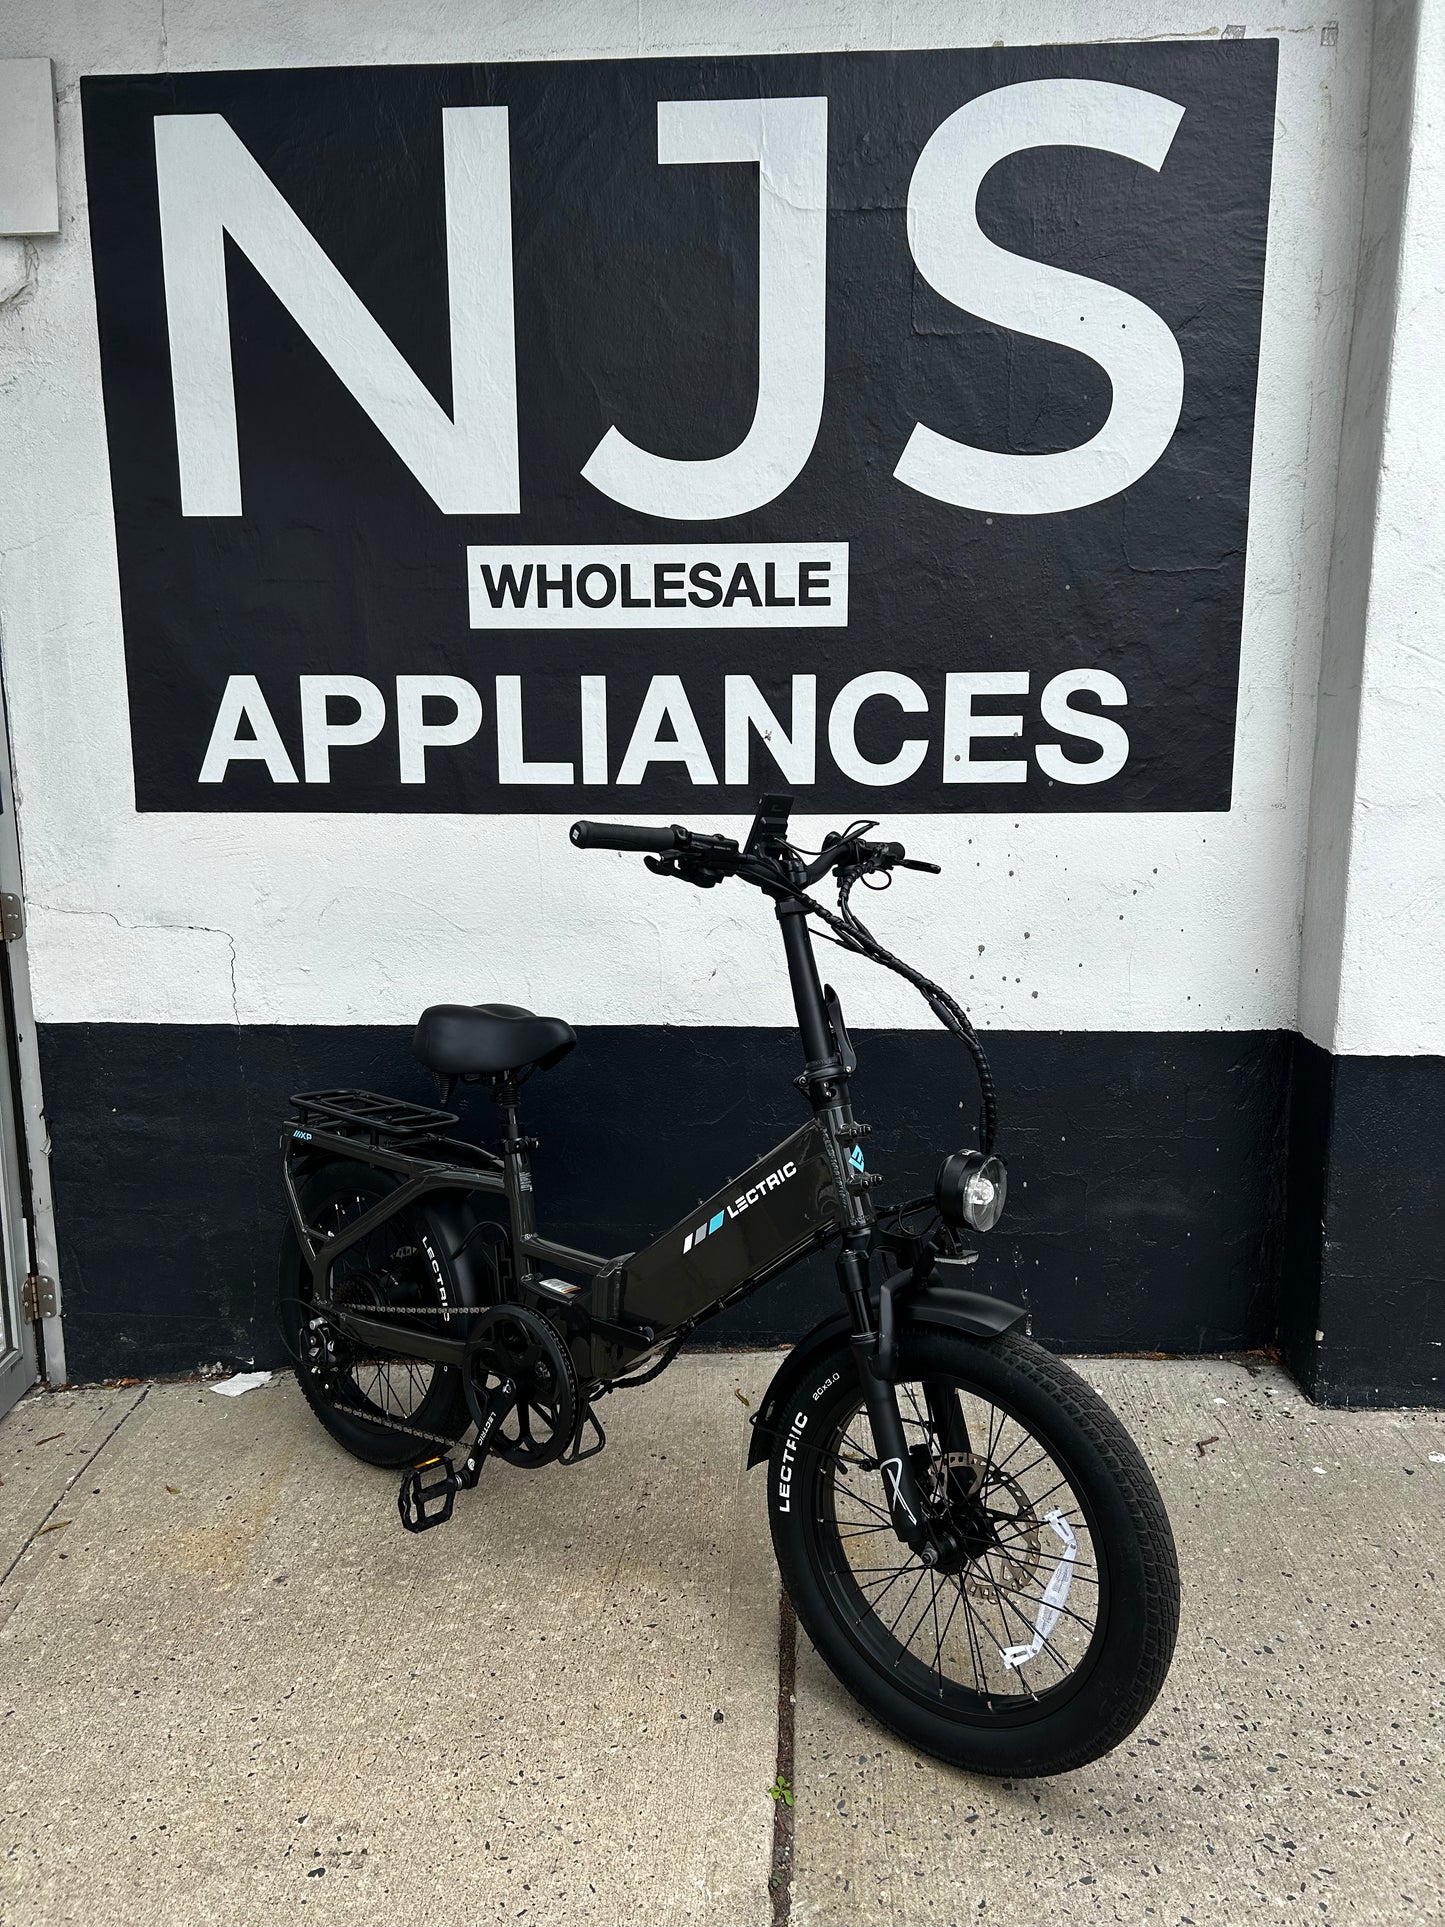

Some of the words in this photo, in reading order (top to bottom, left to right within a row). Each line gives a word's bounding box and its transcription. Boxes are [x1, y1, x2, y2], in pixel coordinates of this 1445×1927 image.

[154, 79, 1186, 520] NJS
[480, 562, 831, 608] WHOLESALE
[198, 669, 1129, 786] APPLIANCES
[726, 1161, 797, 1219] LECTRIC
[812, 1372, 840, 1401] 20x3.0
[478, 1411, 497, 1446] LECTRIC
[779, 1411, 808, 1513] LECTRIC
